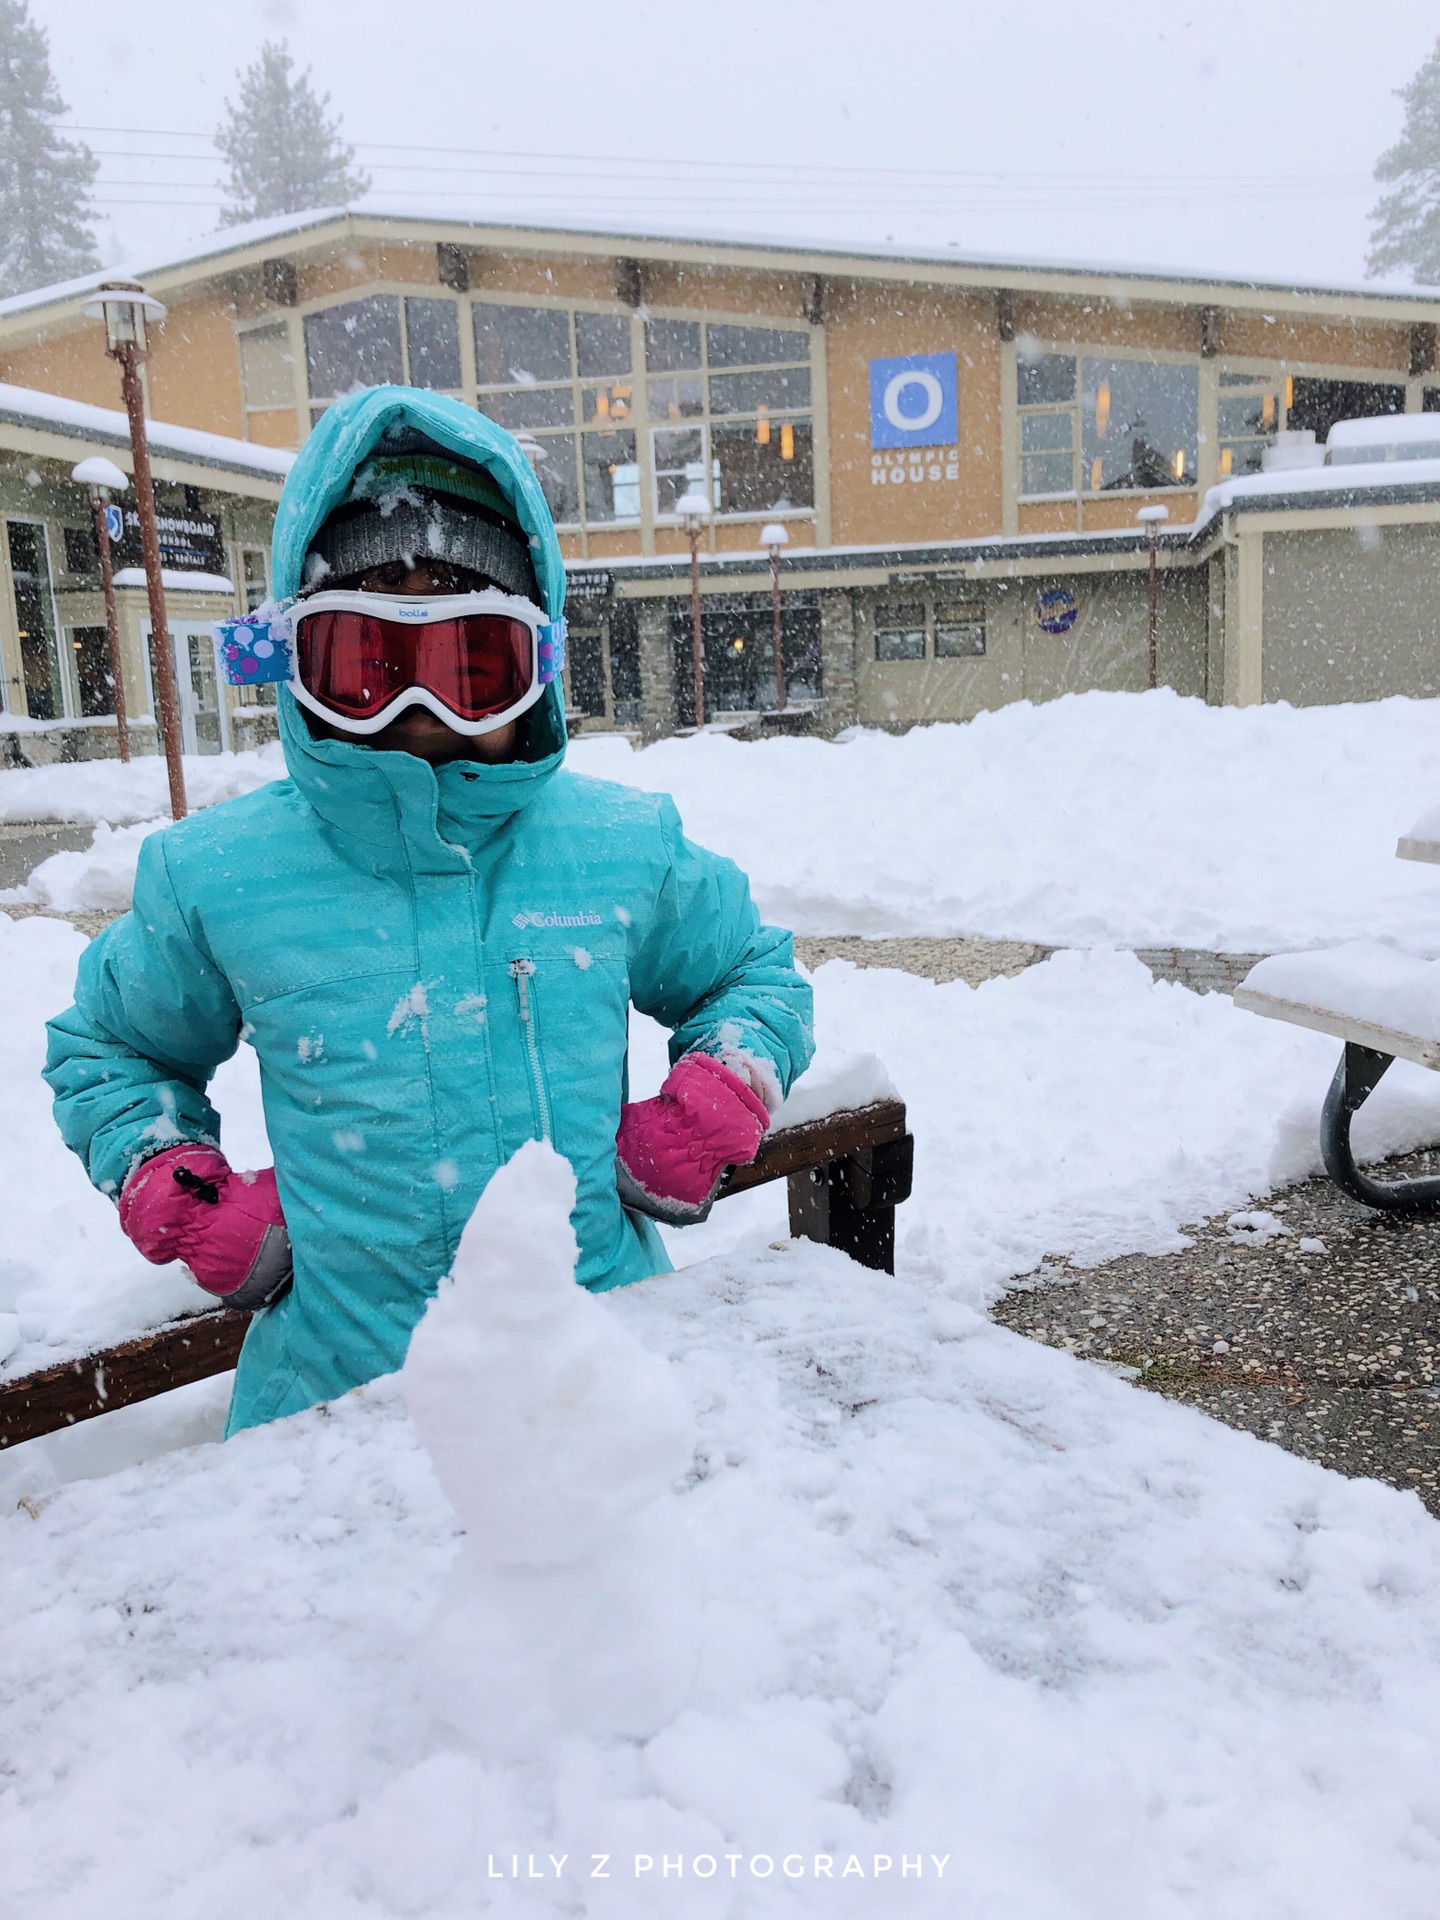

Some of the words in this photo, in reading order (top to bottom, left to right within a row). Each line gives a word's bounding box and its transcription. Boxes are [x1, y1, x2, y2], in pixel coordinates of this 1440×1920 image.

[871, 449, 959, 466] OLYMPIC
[871, 463, 960, 485] HOUSE
[530, 911, 603, 927] Columbia
